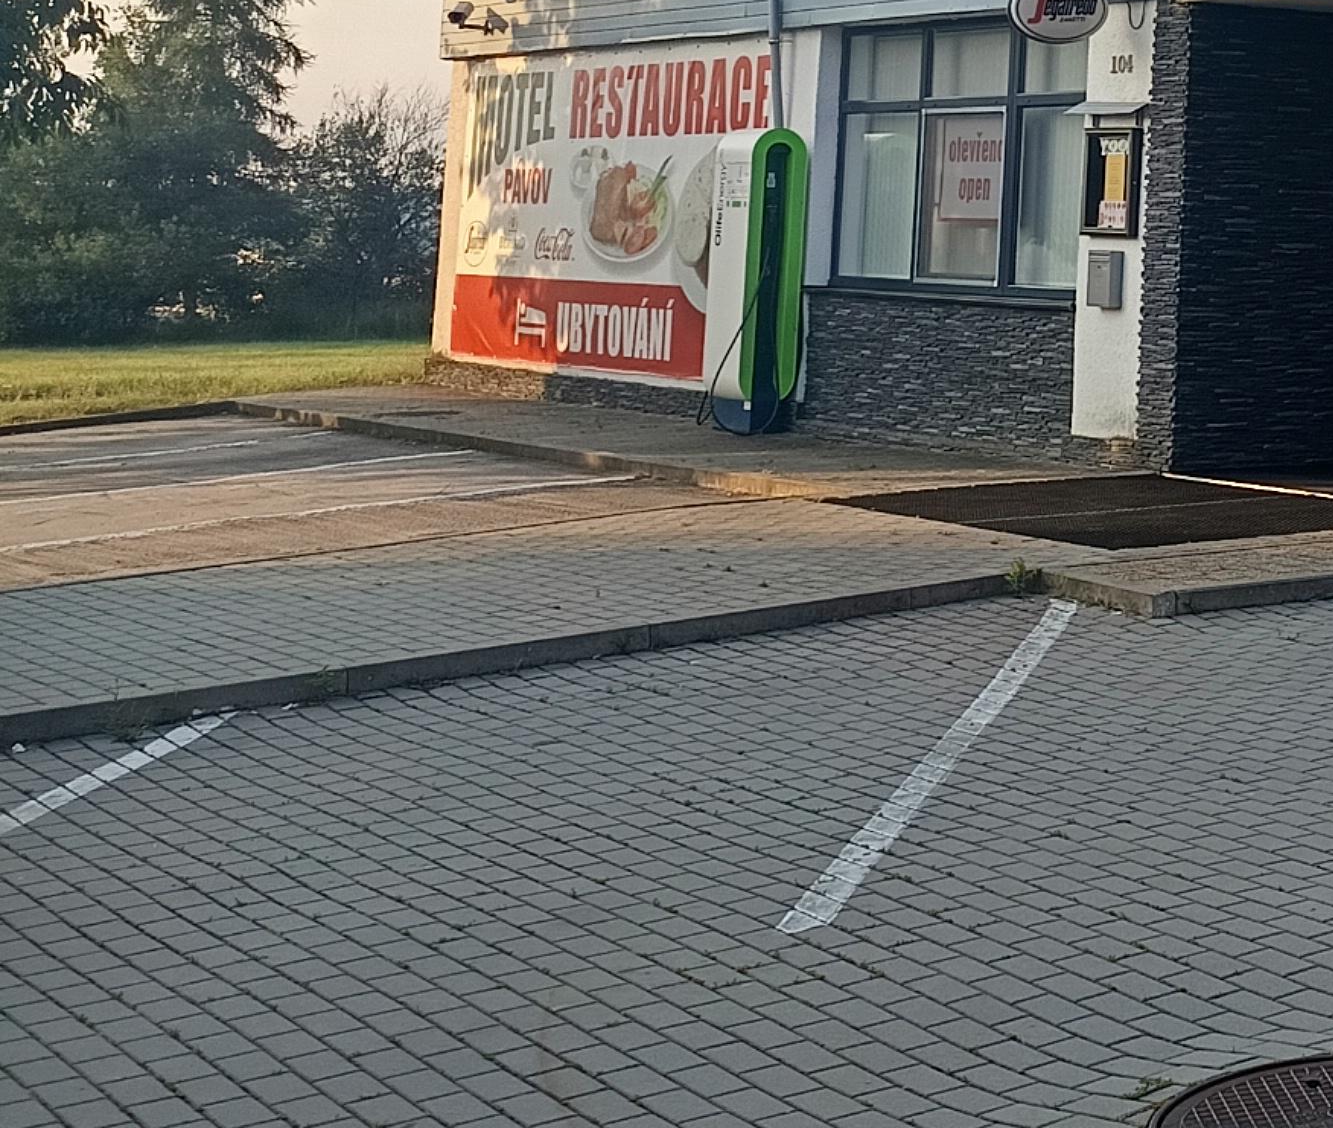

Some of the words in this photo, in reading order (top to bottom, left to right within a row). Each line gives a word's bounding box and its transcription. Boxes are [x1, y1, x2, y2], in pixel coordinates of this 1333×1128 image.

[1110, 55, 1133, 74] 104
[466, 71, 555, 202] MOTEL
[569, 55, 772, 139] RESTAURACE
[958, 178, 991, 203] open
[556, 297, 675, 361] UBYTOVÁNÍ
